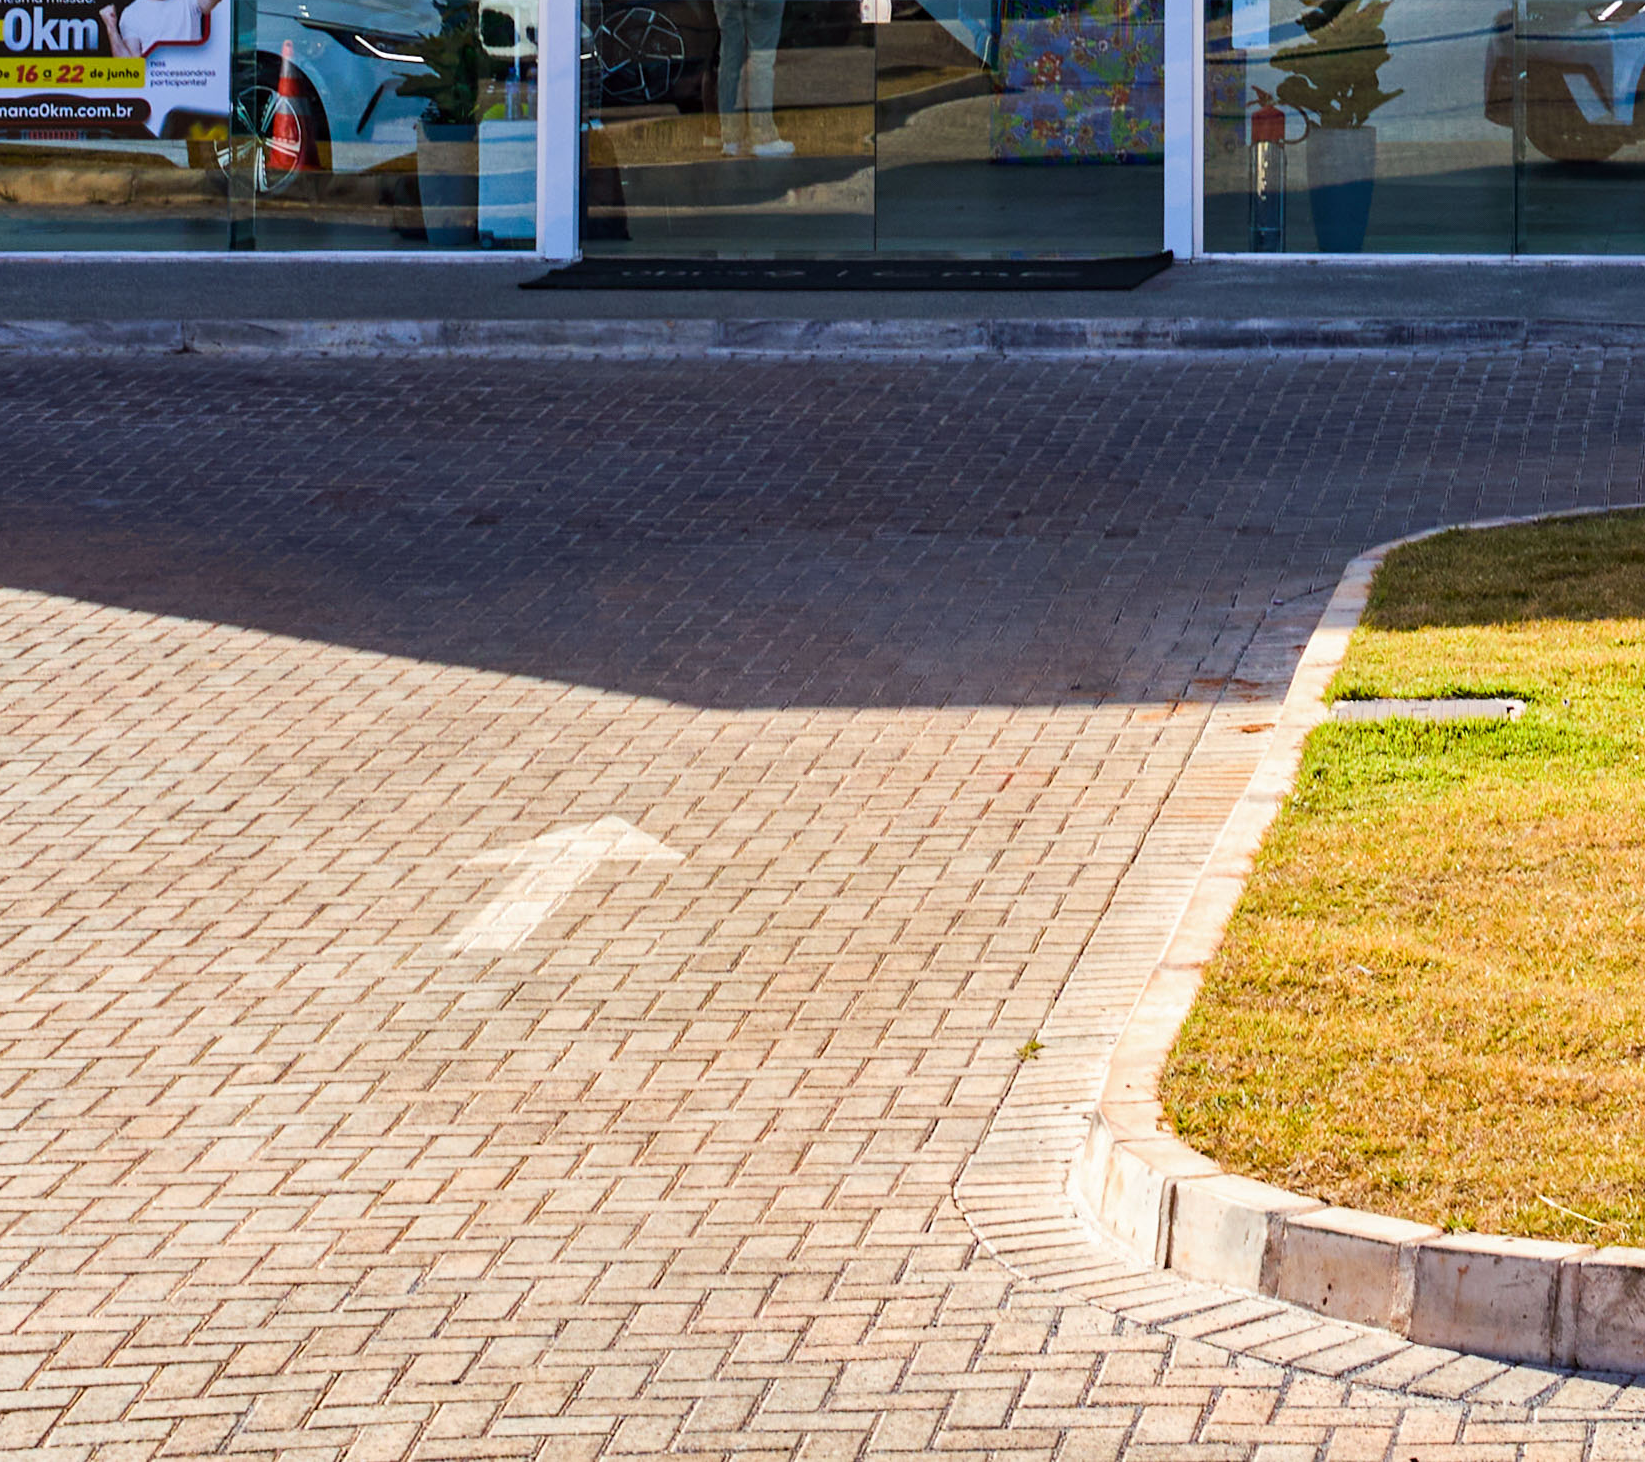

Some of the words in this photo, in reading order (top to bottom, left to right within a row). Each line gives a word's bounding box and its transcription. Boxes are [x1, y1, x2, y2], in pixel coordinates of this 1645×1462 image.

[3, 6, 99, 51] 0km
[16, 65, 39, 83] 16
[56, 65, 85, 83] 22
[90, 69, 104, 79] de
[107, 68, 140, 81] junho
